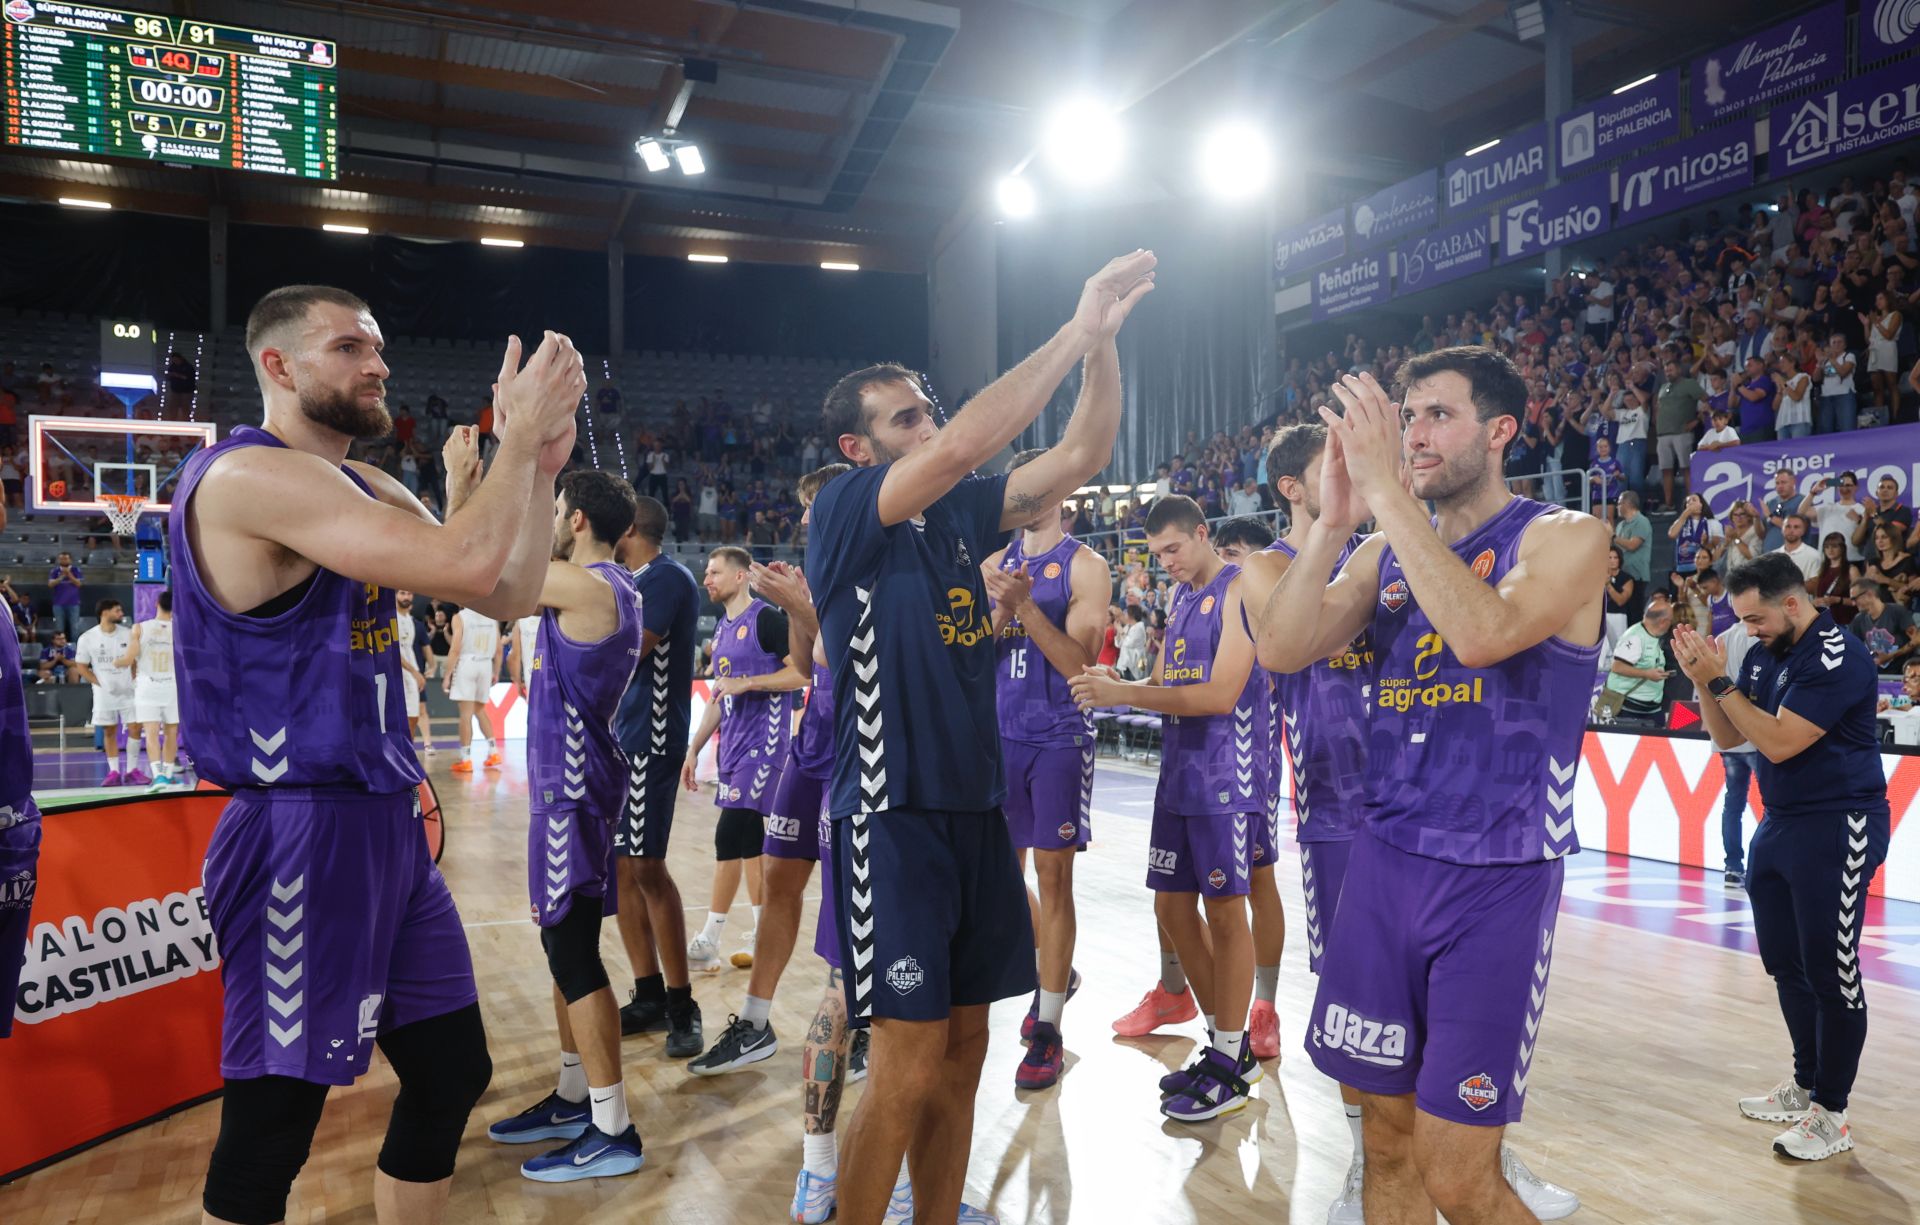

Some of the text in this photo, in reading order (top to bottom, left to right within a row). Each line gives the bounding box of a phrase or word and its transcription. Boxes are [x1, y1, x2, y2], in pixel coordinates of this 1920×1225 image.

[36, 2, 72, 15] SÚPER
[74, 7, 126, 23] AGROPAL
[54, 16, 108, 31] PALENCIA
[134, 17, 162, 37] 96
[189, 25, 215, 45] 91
[132, 47, 146, 56] TO
[252, 34, 306, 50] SAN PABLO
[259, 45, 300, 59] BURGOS
[1725, 24, 1807, 77] Mármoles
[161, 51, 191, 71] 4Q
[206, 57, 219, 66] TO
[1758, 53, 1828, 89] Palencia
[140, 80, 213, 108] 00:00
[1713, 73, 1816, 117] SOMOS FABRICANTES
[148, 116, 160, 132] 5
[1598, 97, 1658, 128] Diputación
[194, 122, 207, 138] 5
[1598, 108, 1672, 146] DE PALENCIA
[160, 141, 220, 155] BALONCESTO
[1449, 145, 1543, 208] HITUMAR
[1663, 141, 1749, 190] nirosa
[1520, 200, 1601, 250] SUEÑO
[1291, 224, 1344, 255] INMAPA
[1427, 226, 1486, 262] GABAN
[1435, 249, 1482, 271] MODA HOMBRE
[1319, 257, 1378, 293] Peñafría
[1320, 281, 1379, 306] Industrias Cárnicas
[114, 324, 140, 338] 0.0
[1762, 453, 1835, 476] súper
[1010, 648, 1027, 679] 15
[1378, 677, 1483, 712] agropal
[1379, 677, 1412, 688] súper
[1149, 846, 1178, 870] aza
[22, 895, 209, 967] ALONCE
[16, 933, 213, 1013] CASTILLA Y
[888, 970, 922, 982] PALENCIA
[1323, 1003, 1406, 1057] gaza
[1461, 1086, 1496, 1101] PALENCIA
